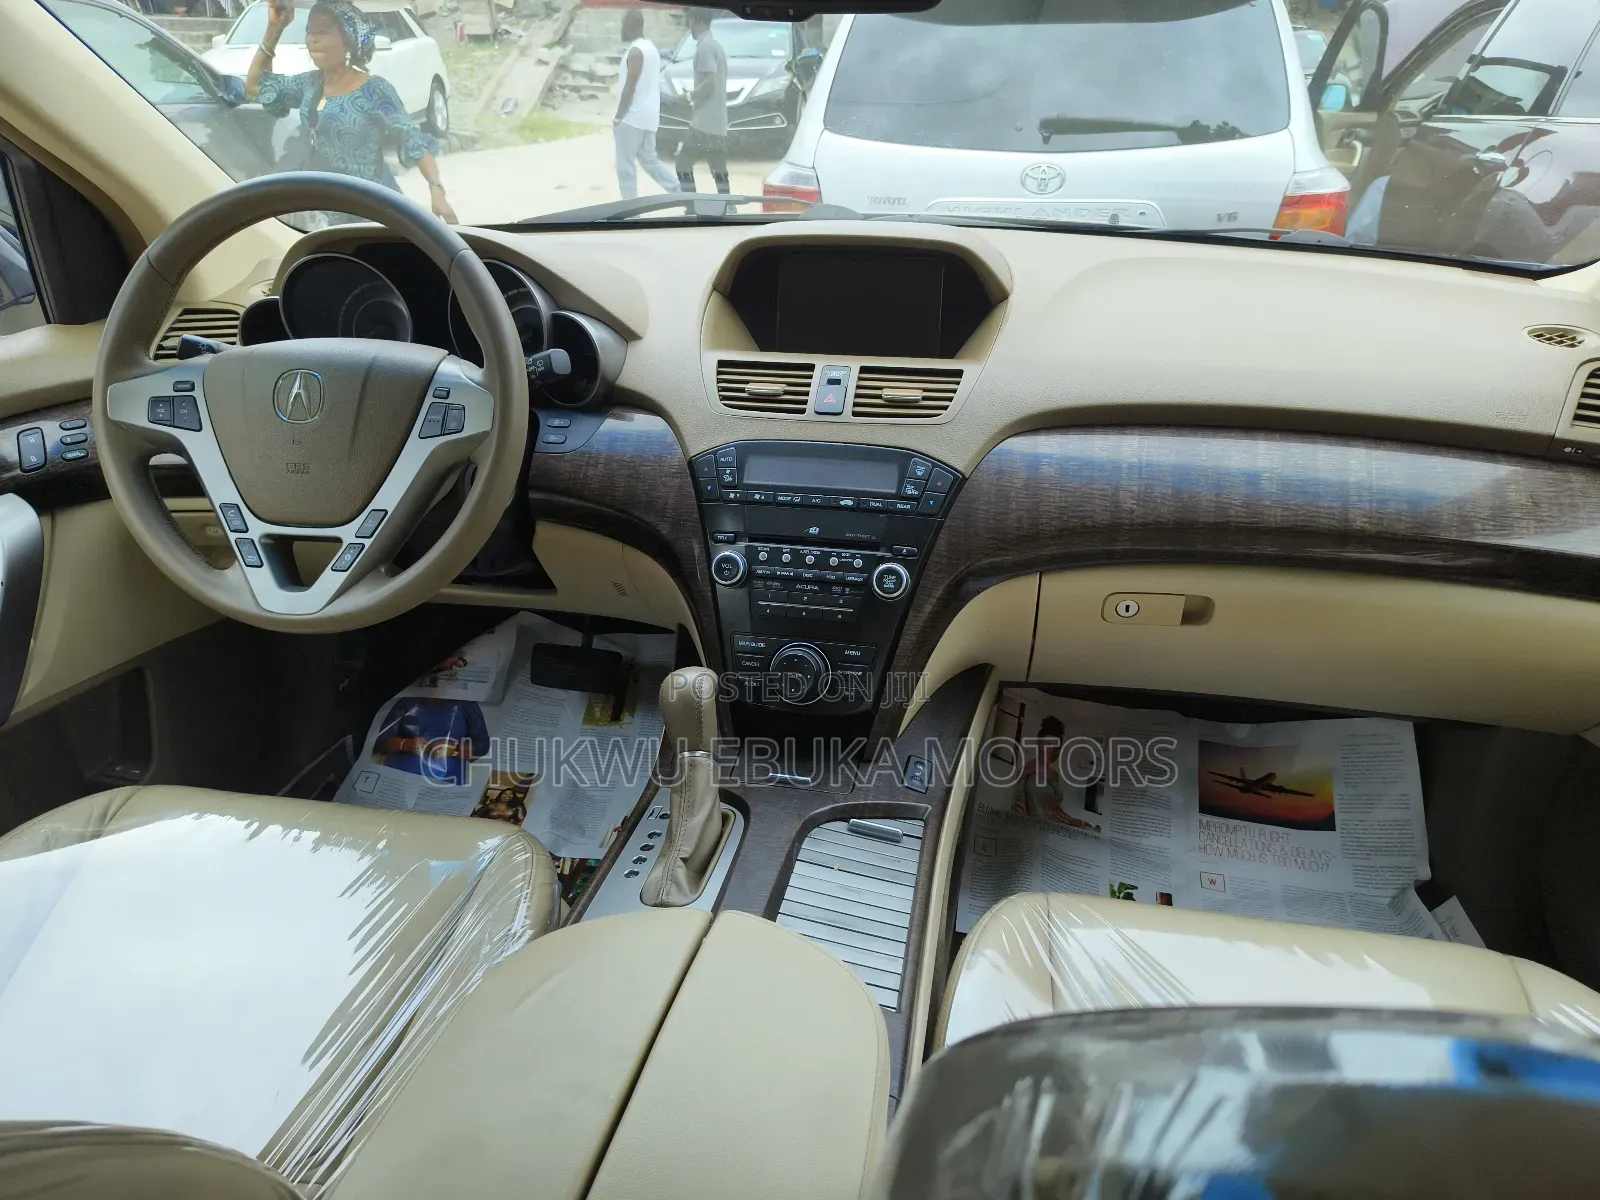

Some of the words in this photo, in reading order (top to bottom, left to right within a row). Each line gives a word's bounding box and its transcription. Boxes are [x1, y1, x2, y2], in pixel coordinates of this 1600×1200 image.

[1217, 211, 1239, 223] V6
[1199, 818, 1256, 839] IMPROMPTU
[1258, 829, 1290, 844] FLIGHT
[1199, 831, 1278, 854] CANCELLATIONS
[1280, 846, 1288, 856] &
[1199, 844, 1225, 857] HOW
[1227, 848, 1256, 862] MUCH
[1258, 854, 1268, 865] IS
[1272, 855, 1292, 869] TOO
[1295, 859, 1330, 875] MUCH?
[1208, 877, 1217, 886] W
